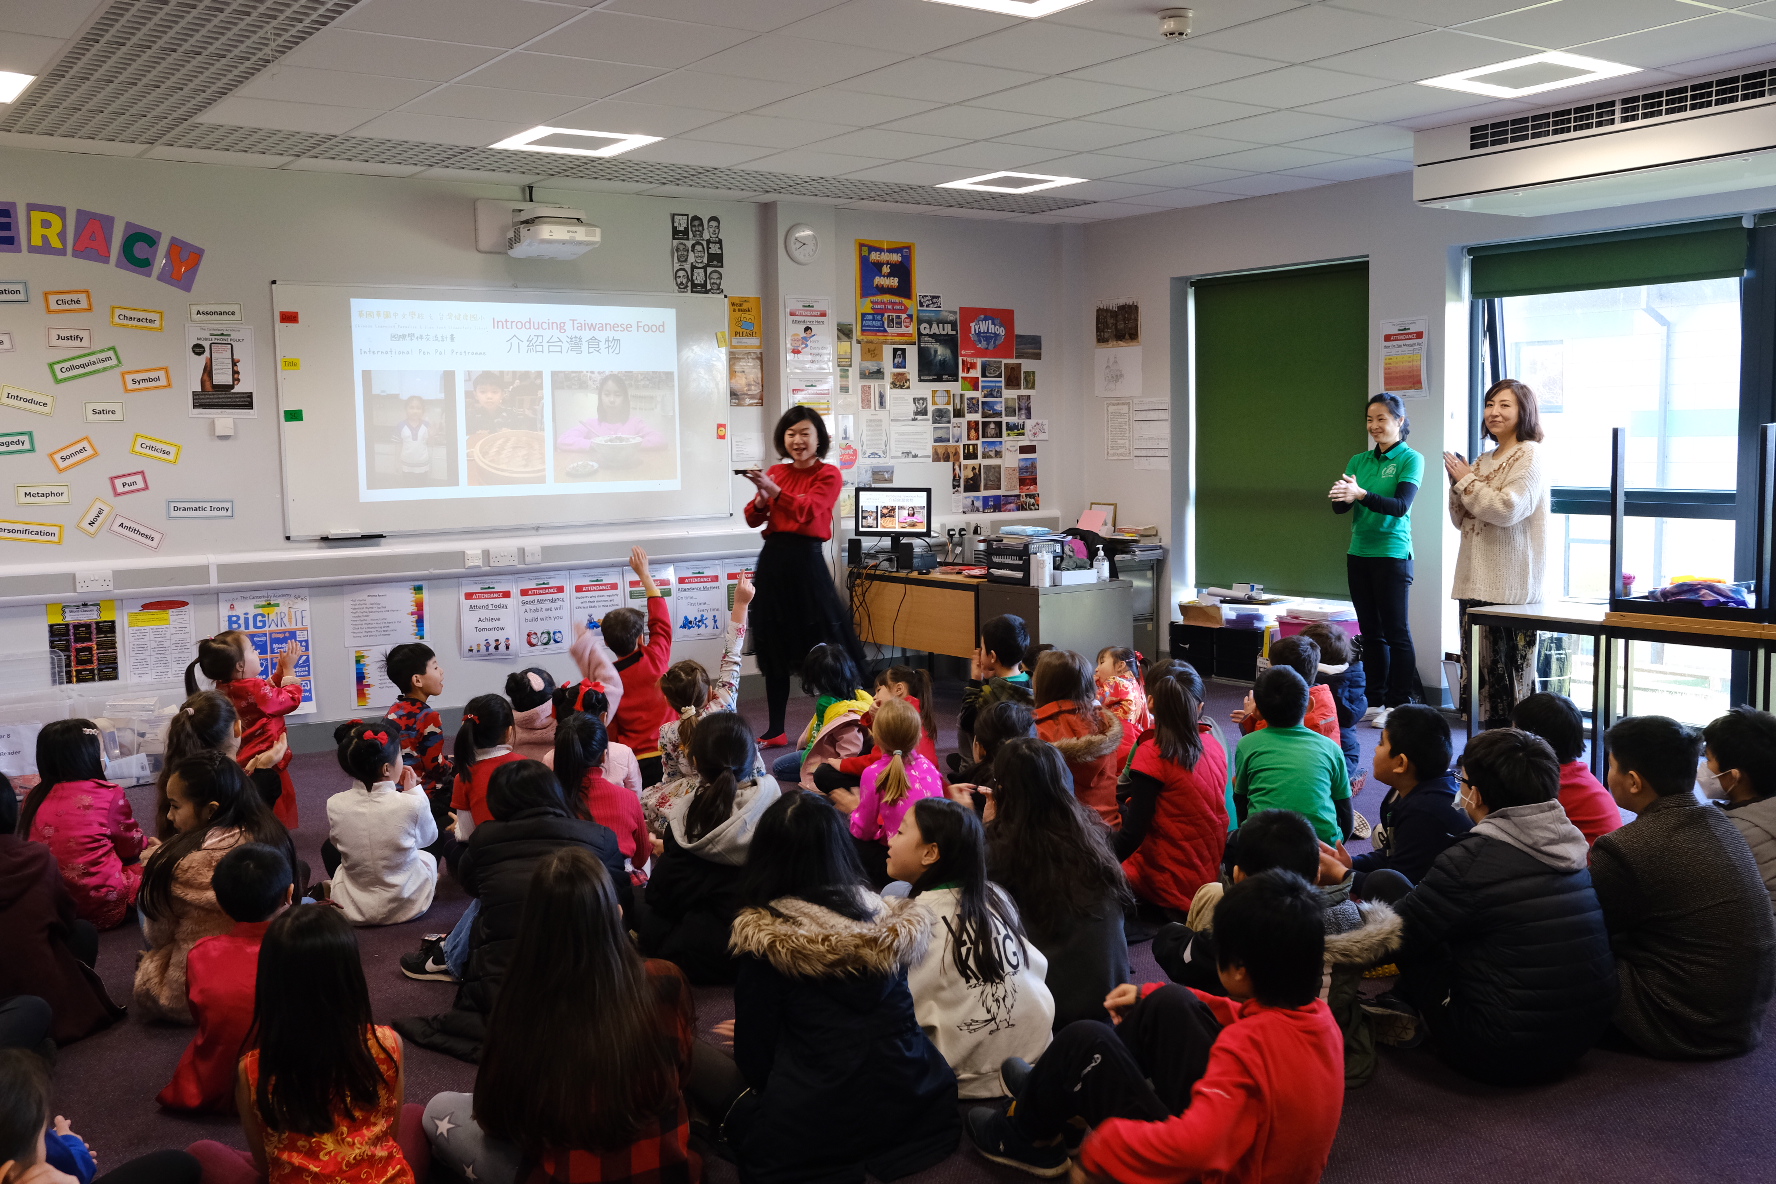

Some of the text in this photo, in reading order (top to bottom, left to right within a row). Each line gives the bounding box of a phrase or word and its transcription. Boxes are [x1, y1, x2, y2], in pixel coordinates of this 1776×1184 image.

[870, 252, 902, 263] READING
[882, 265, 891, 275] AS
[874, 277, 899, 288] POWER
[55, 297, 82, 306] Cliché
[196, 309, 236, 317] Assonance
[117, 314, 157, 326] Character
[492, 317, 567, 334] Introducing
[569, 318, 633, 333] Taiwanese
[636, 320, 666, 333] Food
[56, 333, 84, 344] Justify
[506, 333, 621, 355] 介紹台灣食物
[359, 347, 413, 355] International
[435, 348, 446, 356] Pal
[59, 355, 113, 375] Colloquialism
[131, 375, 161, 386] Symbol
[6, 391, 49, 409] Introduce
[91, 408, 117, 416] Satire
[59, 446, 88, 463] Sonnet
[139, 442, 172, 456] Criticise
[121, 479, 138, 489] Pun
[24, 491, 65, 499] Metaphor
[173, 505, 231, 514] Dramatic Irony
[87, 507, 105, 528] Novel
[117, 521, 156, 543] Antithesis
[527, 587, 558, 595] ATTENDANCE
[469, 603, 510, 611] Attend Today
[521, 598, 536, 606] Good
[536, 597, 566, 605] Attendance
[552, 615, 564, 623] you
